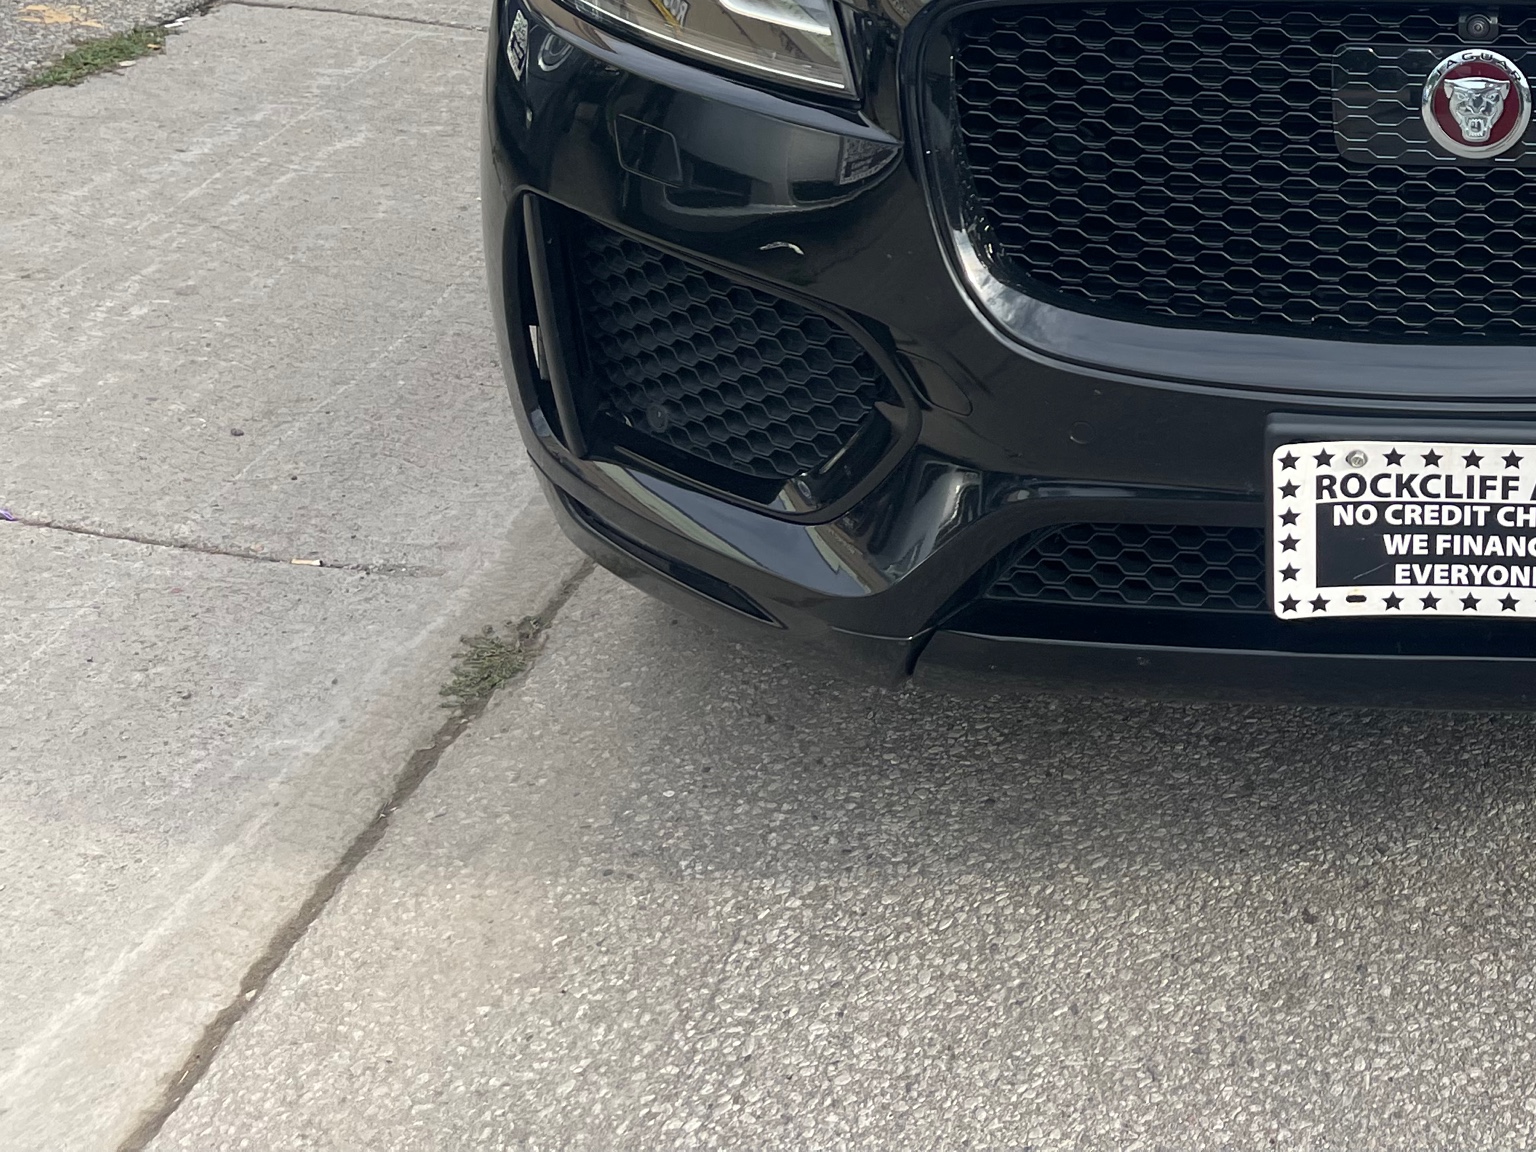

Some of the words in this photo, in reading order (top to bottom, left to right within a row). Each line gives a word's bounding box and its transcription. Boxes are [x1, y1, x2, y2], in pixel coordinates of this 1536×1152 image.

[1435, 51, 1522, 83] JAGUAR
[1315, 473, 1521, 501] ROCKCLIFF
[1332, 504, 1379, 526] NO
[1384, 504, 1491, 527] CREDIT
[1383, 533, 1429, 556] WE
